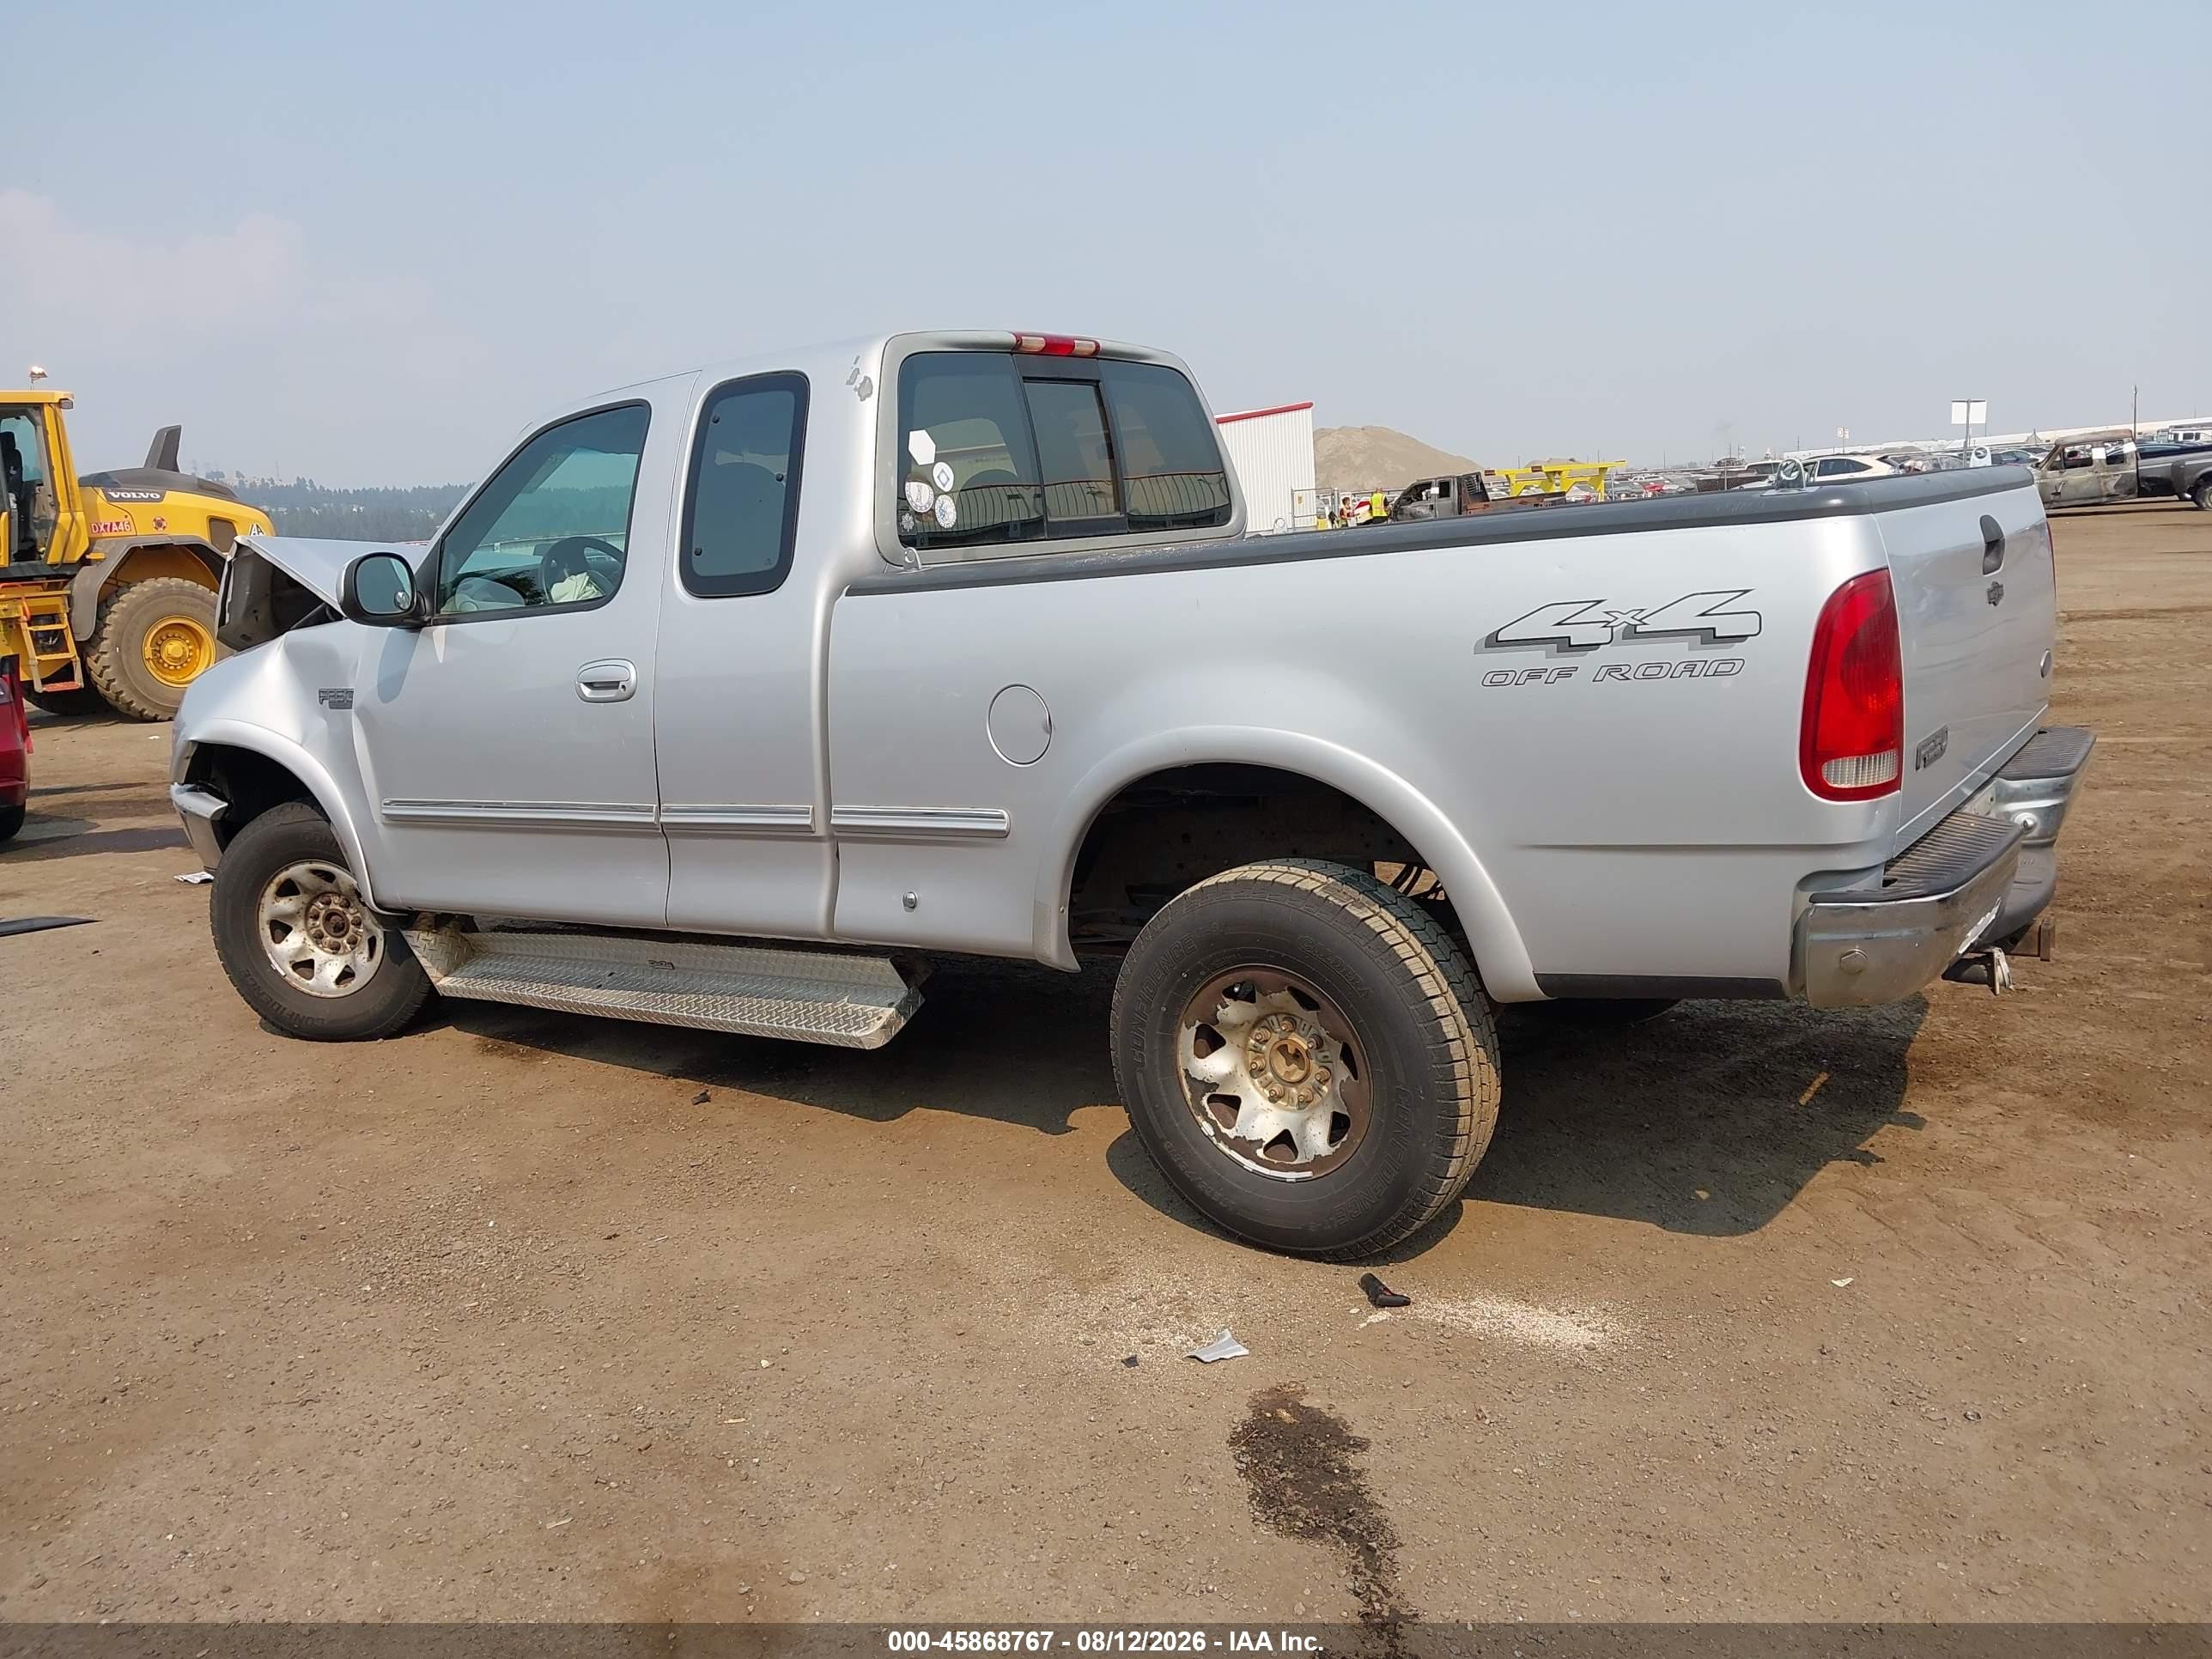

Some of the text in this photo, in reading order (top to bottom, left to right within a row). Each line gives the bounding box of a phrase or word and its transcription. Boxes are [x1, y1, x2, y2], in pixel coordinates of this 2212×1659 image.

[91, 520, 131, 533] DX7A46
[1481, 658, 1745, 687] OFF ROAD
[1131, 933, 1198, 1067] CONFIDENCE
[1333, 1085, 1413, 1226] CONFIDENCE
